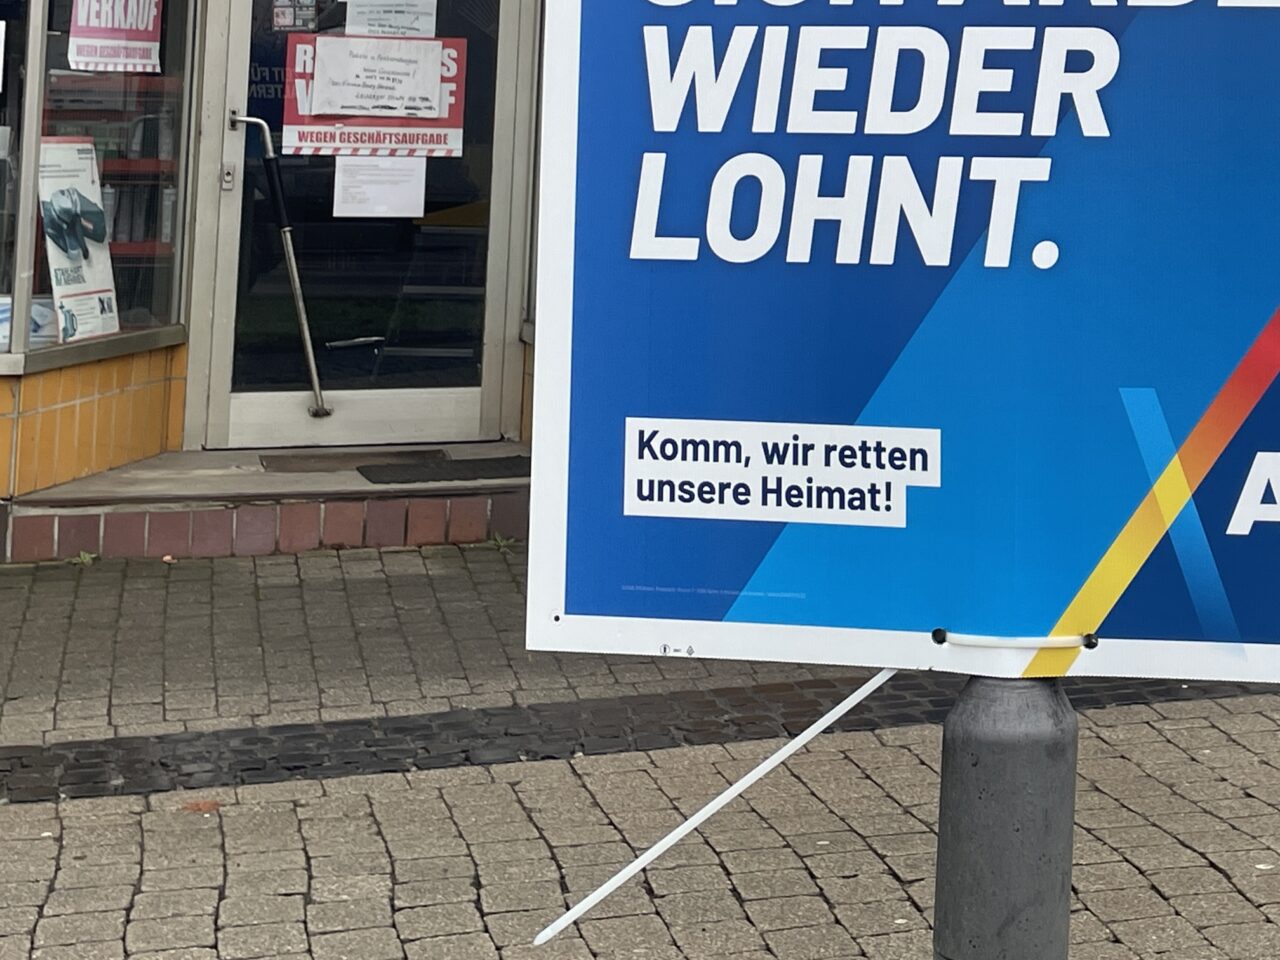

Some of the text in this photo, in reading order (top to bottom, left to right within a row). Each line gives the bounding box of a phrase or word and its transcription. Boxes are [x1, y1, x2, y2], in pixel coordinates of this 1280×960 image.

[642, 24, 1120, 137] WIEDER
[298, 130, 449, 145] WEGEN GESCHÄFTSAUFGABE
[629, 152, 1060, 270] LOHNT.
[637, 429, 929, 472] Komm, wir retten
[637, 476, 892, 512] unsere Heimat!
